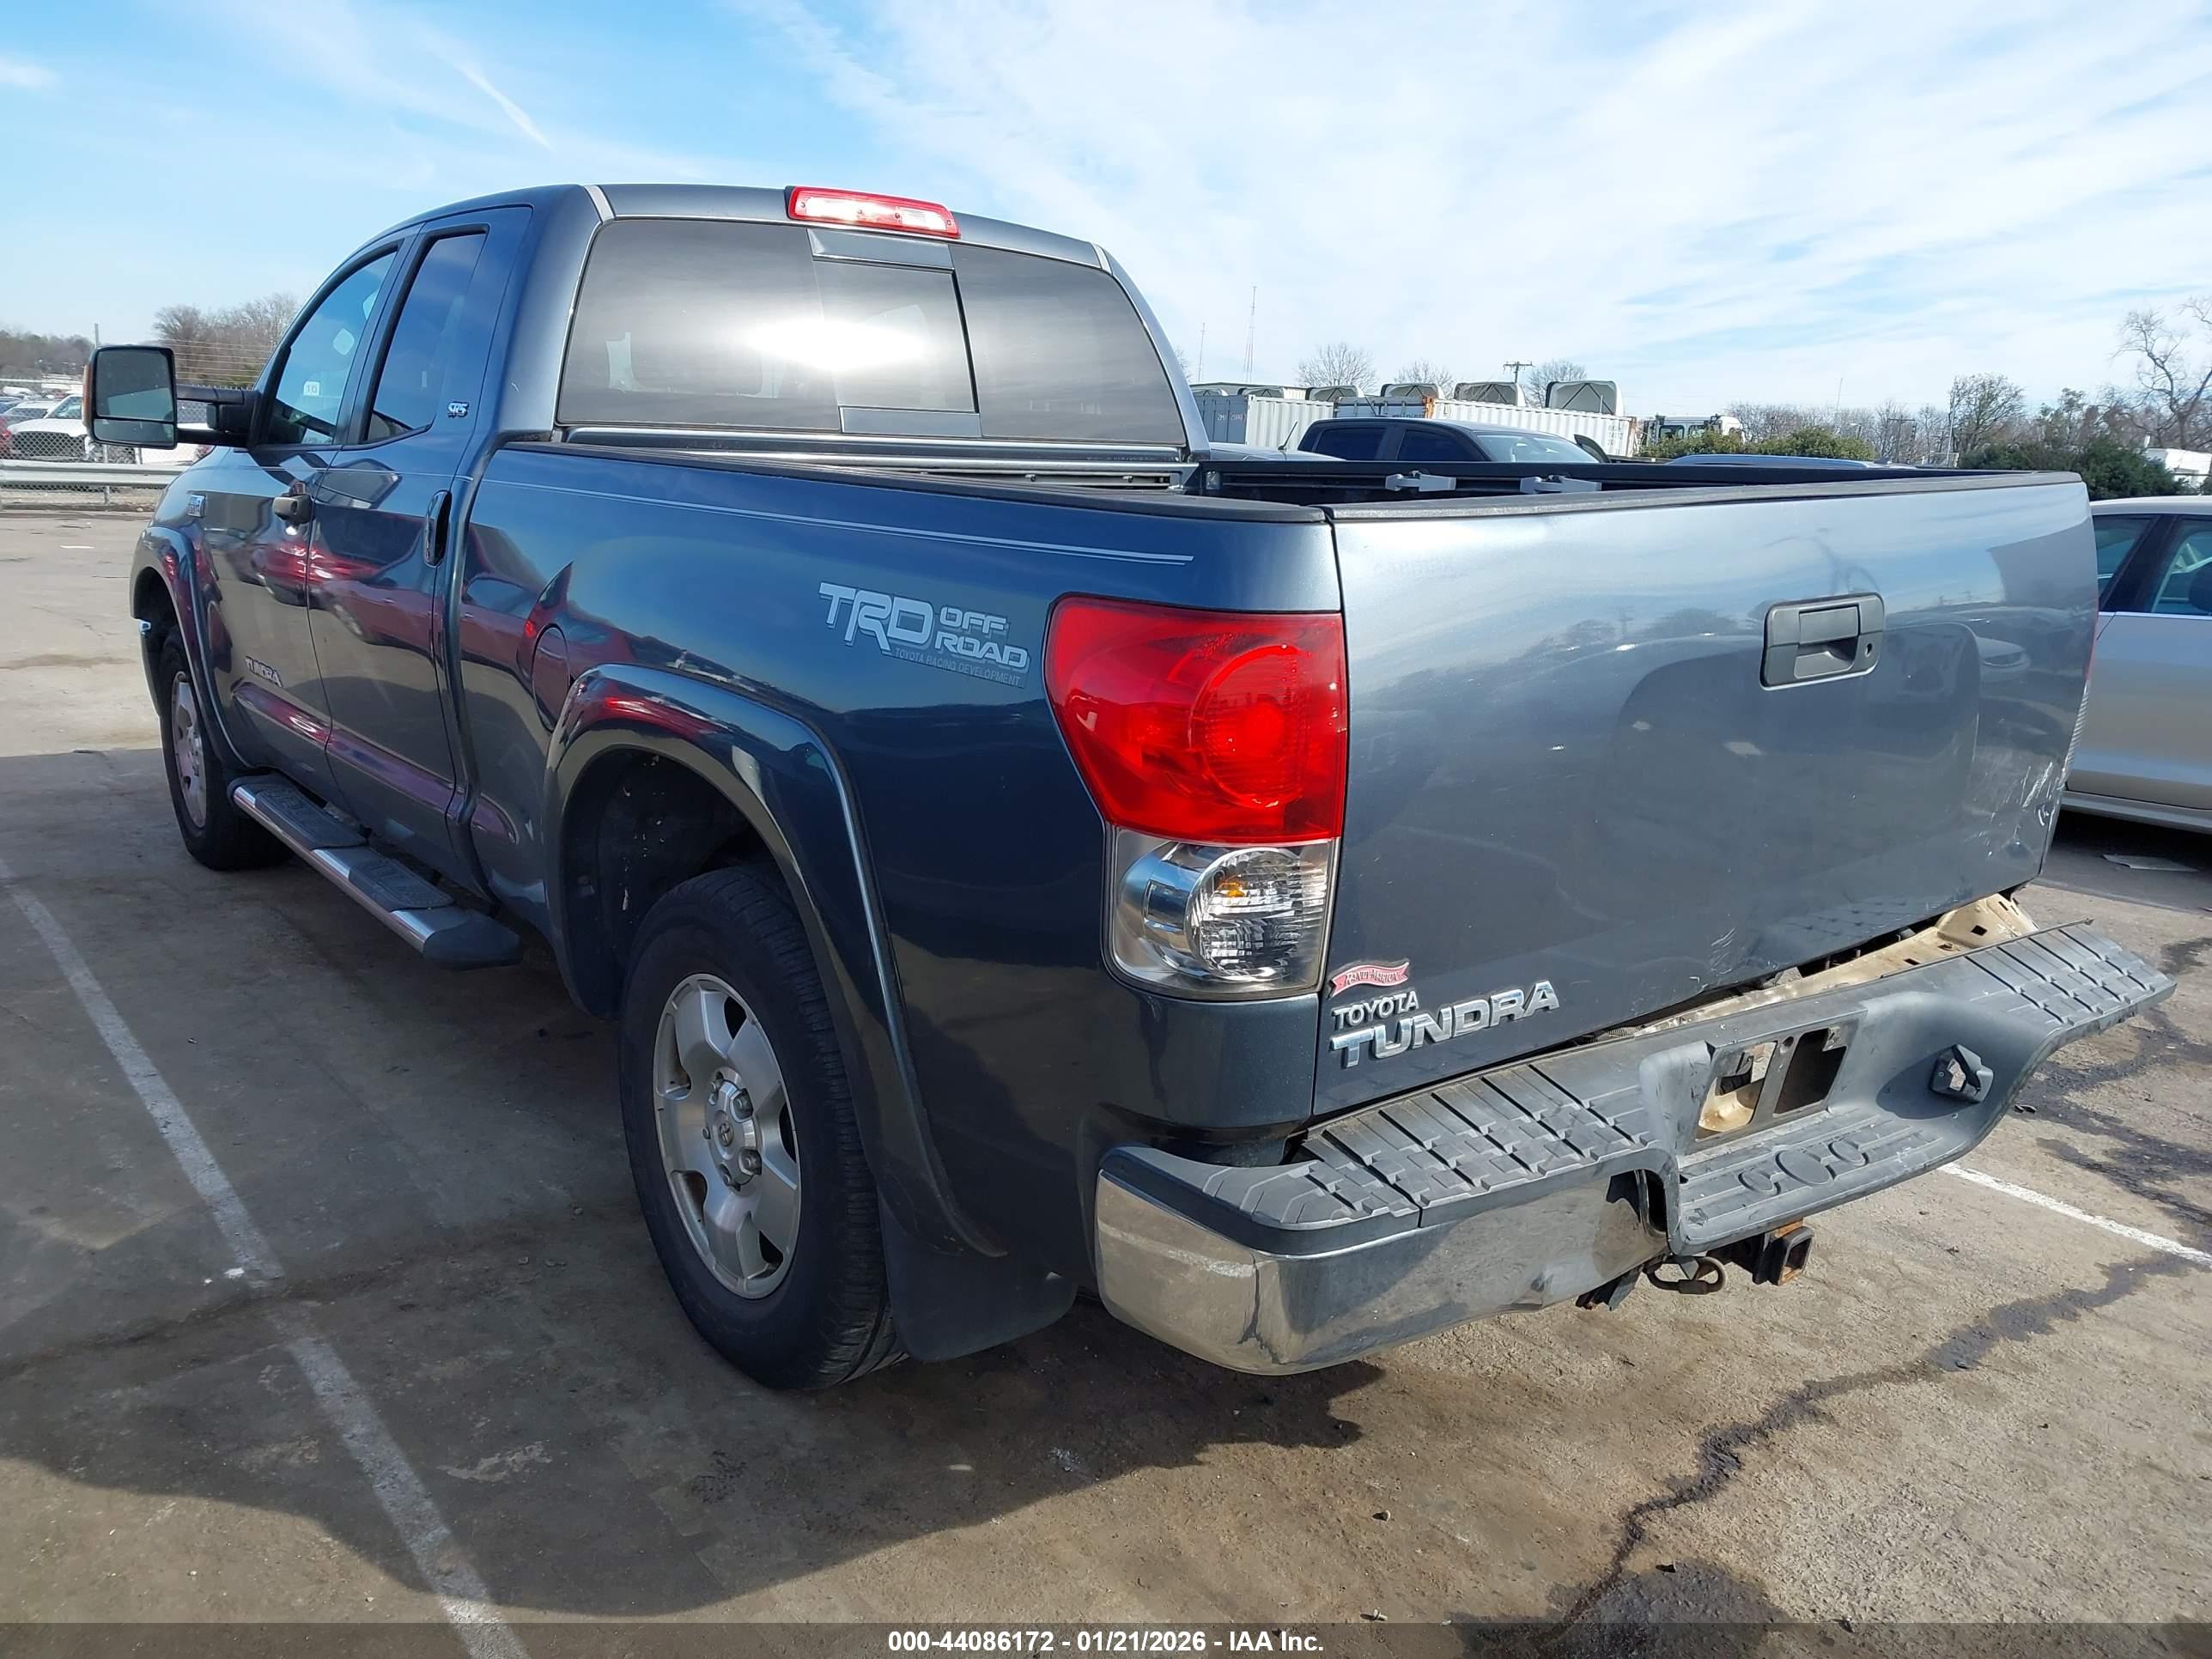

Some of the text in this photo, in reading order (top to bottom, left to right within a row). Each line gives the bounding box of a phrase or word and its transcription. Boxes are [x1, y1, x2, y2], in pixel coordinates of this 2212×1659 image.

[818, 581, 934, 653] TRD
[939, 605, 1008, 634] OFF
[896, 647, 1022, 686] TOYOTA RACING DEVELOPMENT
[934, 630, 1030, 669] ROAD
[1331, 980, 1560, 1068] TUNDRA
[1332, 990, 1419, 1029] TOYOTA
